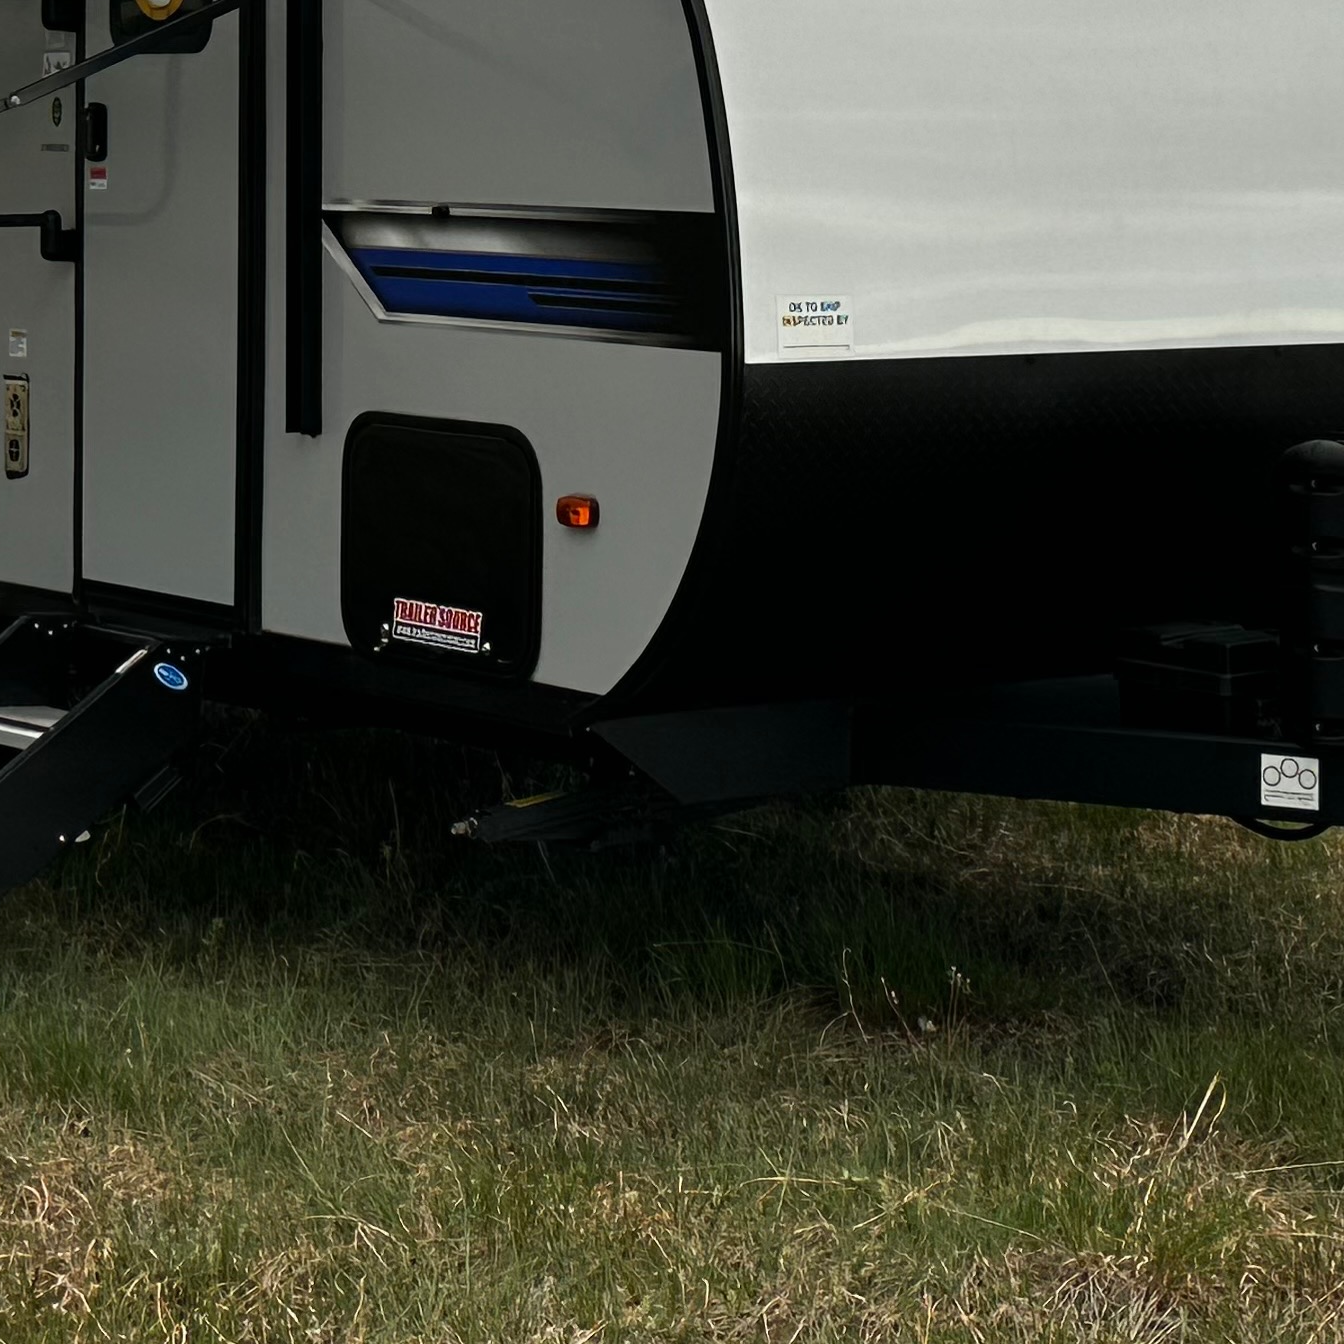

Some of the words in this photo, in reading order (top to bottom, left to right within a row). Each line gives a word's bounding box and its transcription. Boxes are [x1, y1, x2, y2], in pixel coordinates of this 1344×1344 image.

[805, 301, 818, 312] TO
[394, 599, 437, 626] TRAILER
[437, 606, 482, 633] SOURCE
